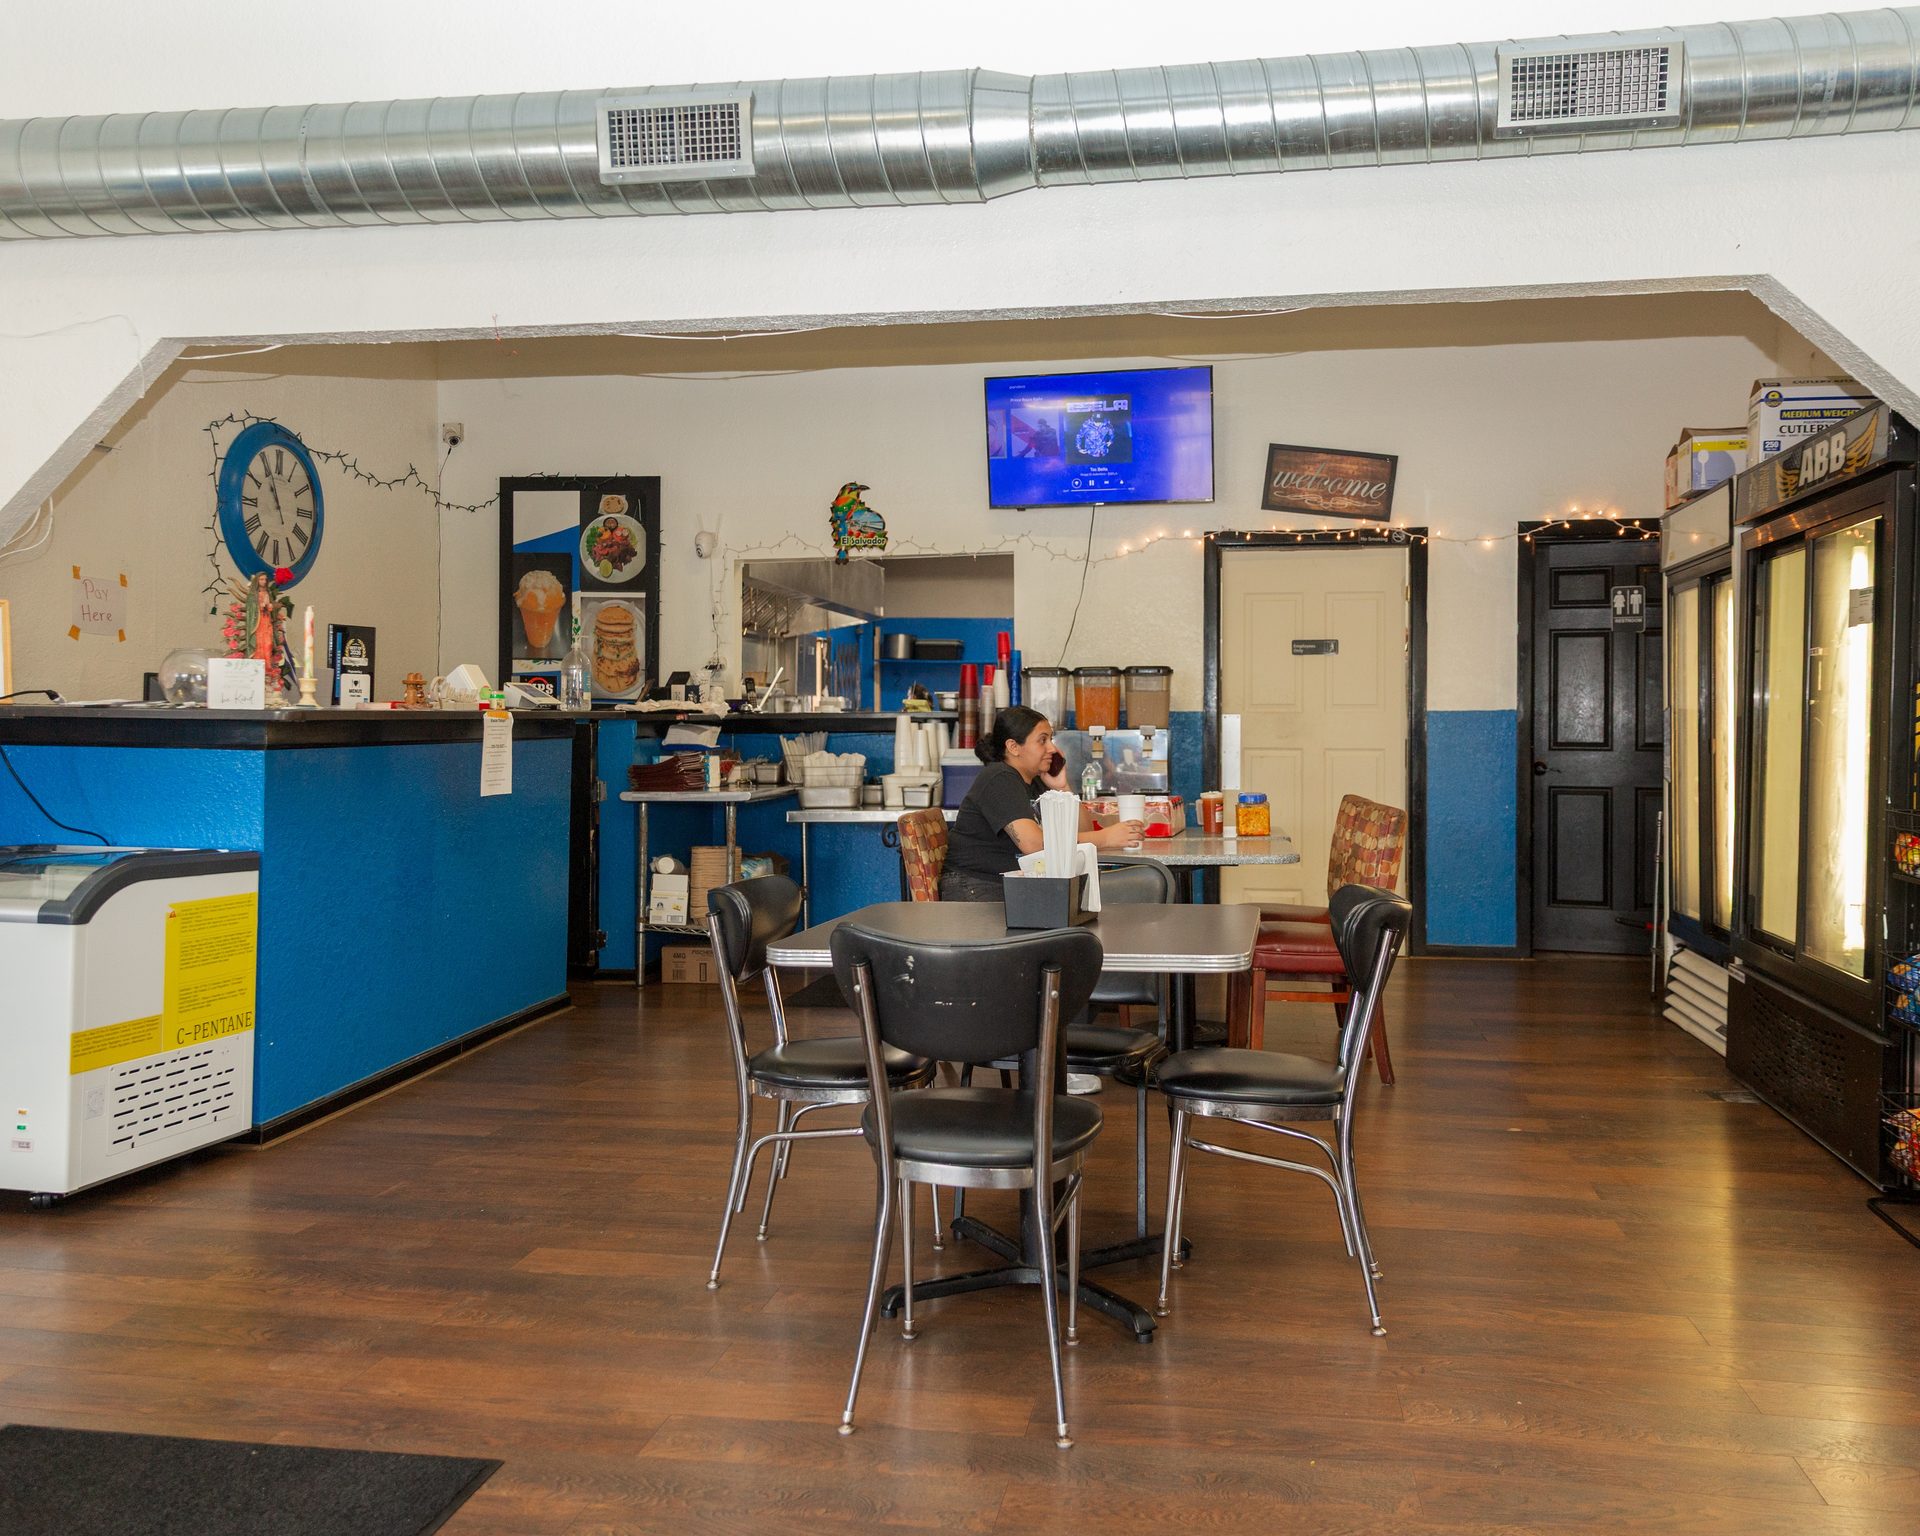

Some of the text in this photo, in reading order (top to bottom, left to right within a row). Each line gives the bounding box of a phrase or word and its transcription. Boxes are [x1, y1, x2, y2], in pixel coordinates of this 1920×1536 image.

[1765, 441, 1779, 449] 250
[1799, 431, 1846, 487] ABB
[1273, 462, 1387, 500] welcome
[841, 535, 885, 545] El Salvador
[82, 578, 109, 600] Pay
[81, 604, 112, 622] Here
[176, 1011, 253, 1045] C-PENTANE
